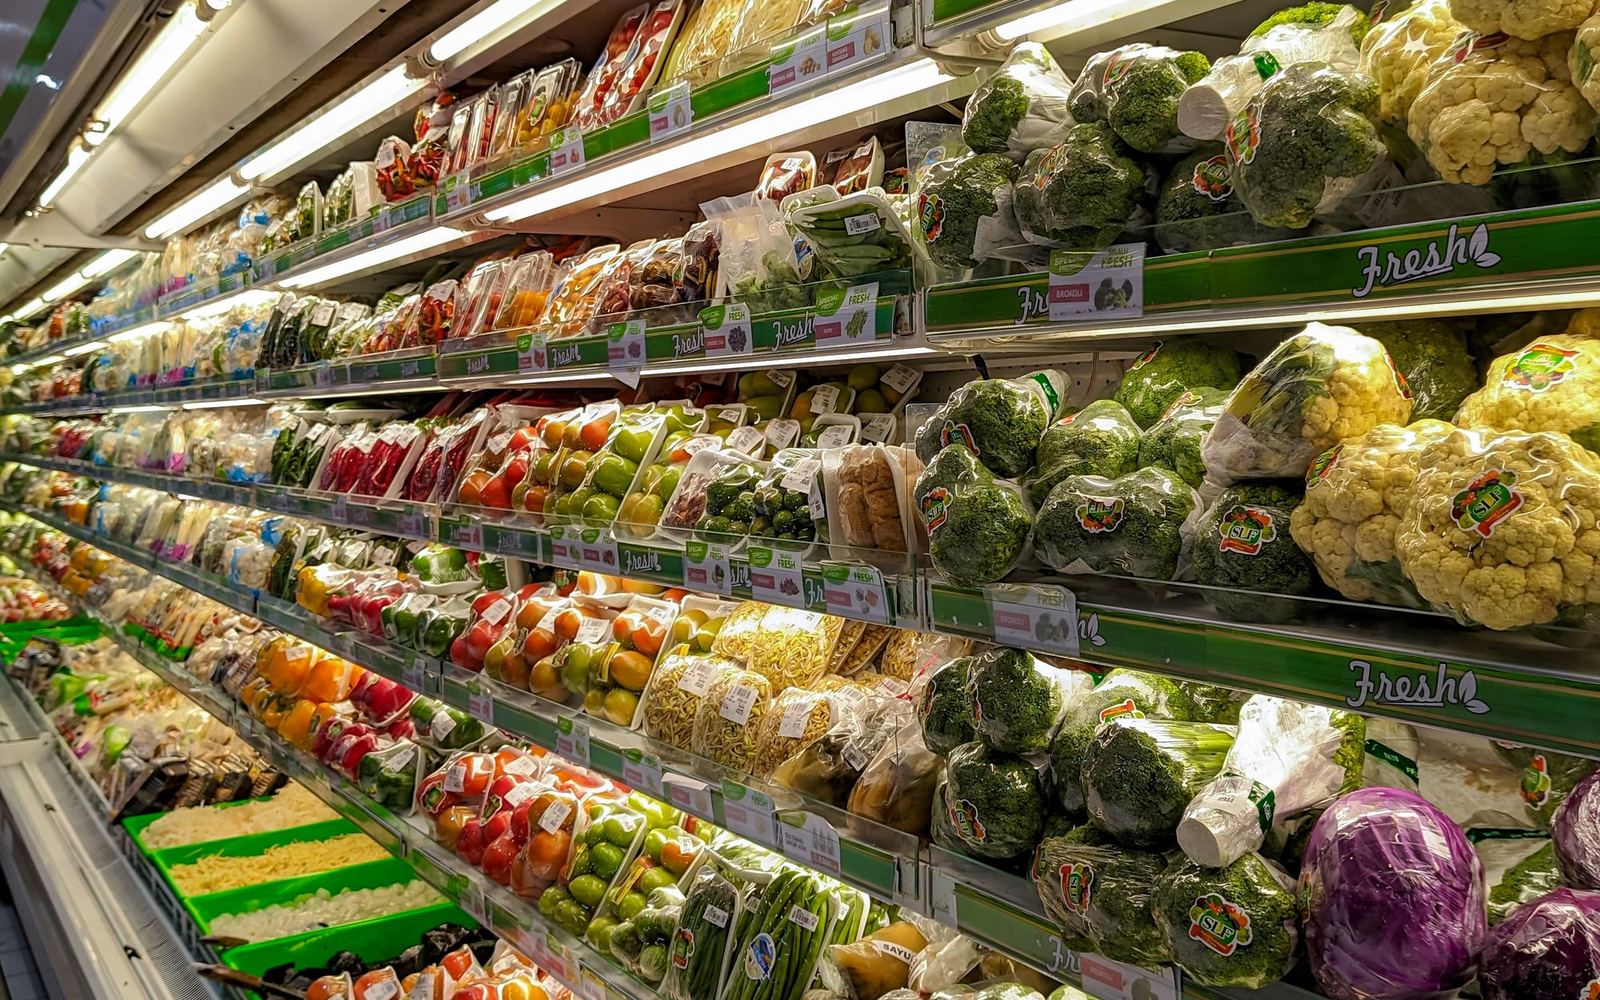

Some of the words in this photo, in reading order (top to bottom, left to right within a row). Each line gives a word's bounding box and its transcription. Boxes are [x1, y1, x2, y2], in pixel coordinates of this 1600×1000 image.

[1352, 224, 1468, 297] Fresh
[849, 293, 870, 305] FRESH
[1056, 290, 1083, 298] BROKOLI
[729, 312, 745, 321] FRESH
[673, 326, 704, 360] Fresh
[772, 311, 814, 351] Fresh
[552, 344, 577, 370] Fresh
[1472, 485, 1503, 519] SLF
[1230, 525, 1260, 542] SLF
[624, 550, 657, 576] Fresh
[777, 558, 796, 569] FRESH
[854, 572, 875, 582] FRESH
[1347, 661, 1458, 707] Fresh
[1201, 915, 1235, 940] SLF
